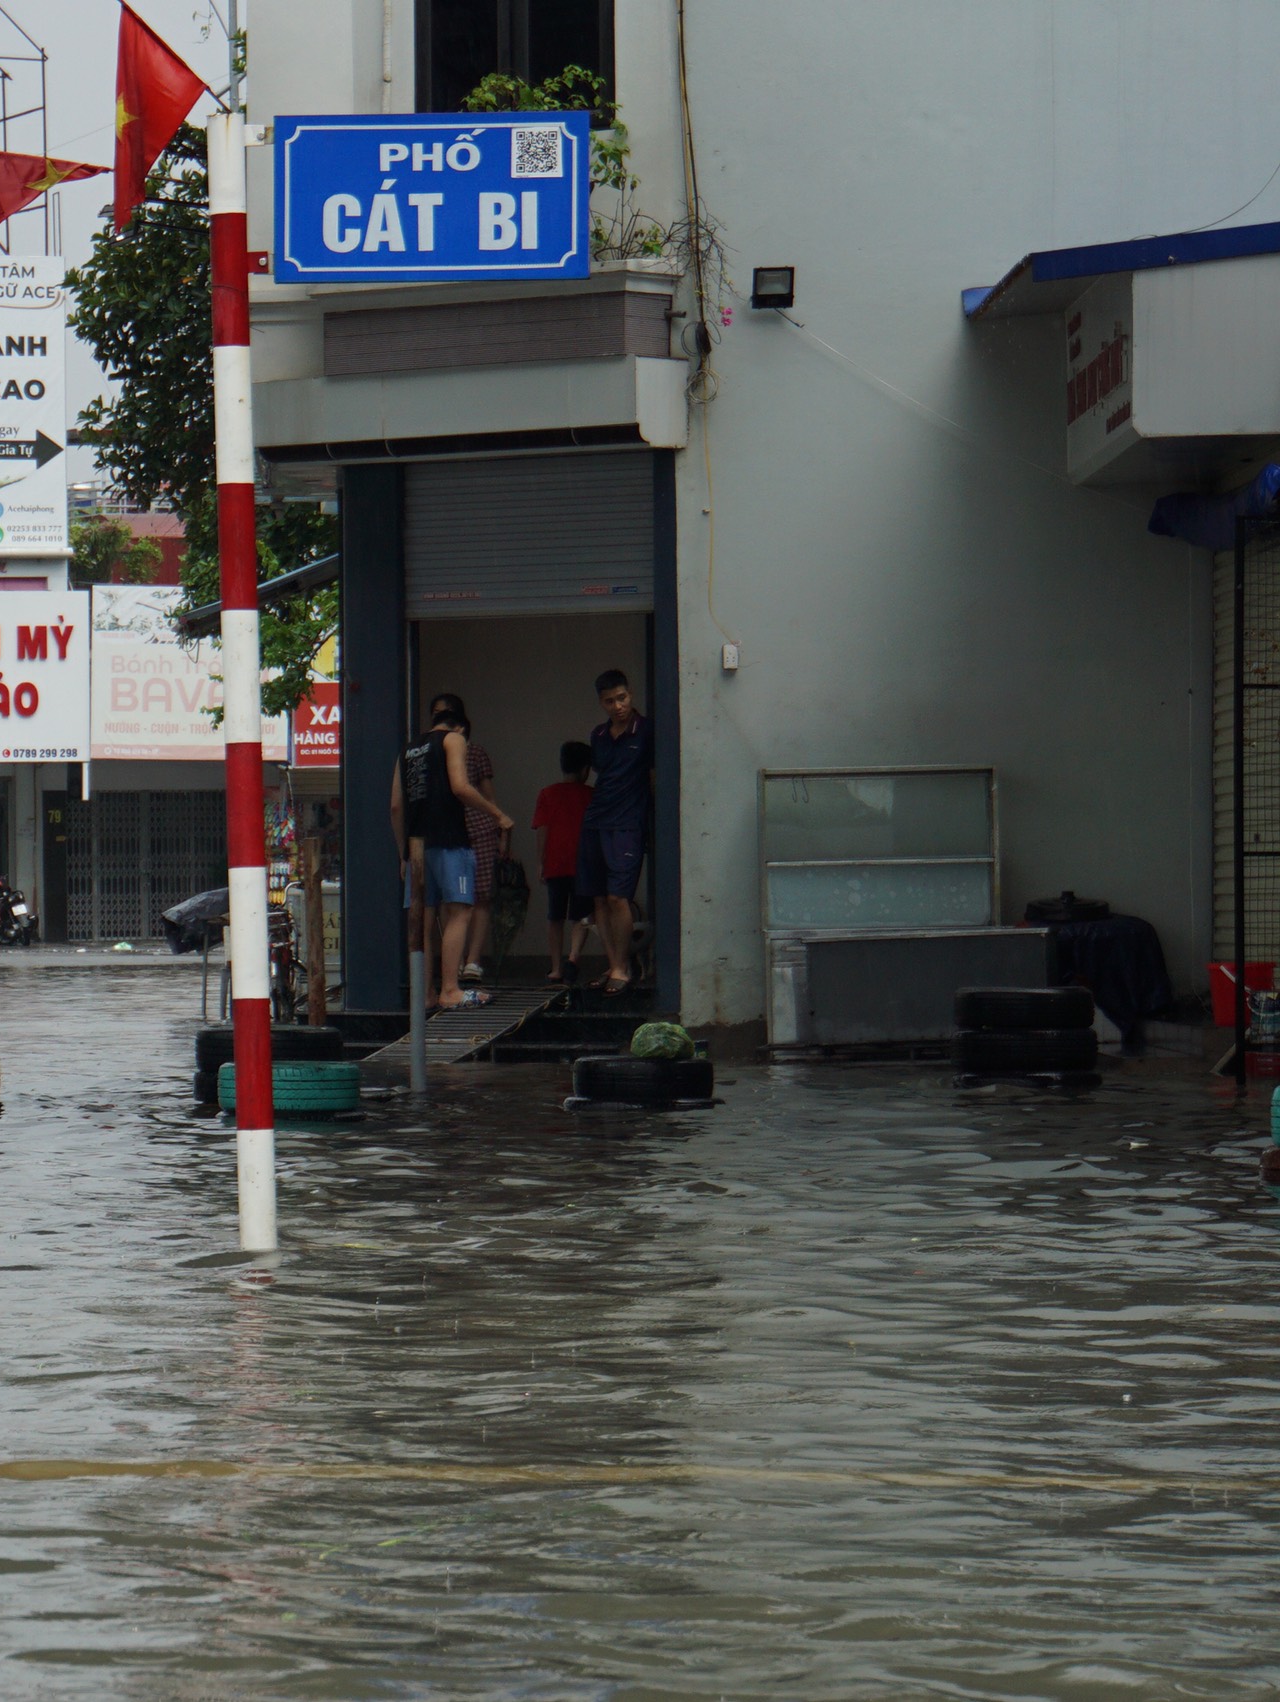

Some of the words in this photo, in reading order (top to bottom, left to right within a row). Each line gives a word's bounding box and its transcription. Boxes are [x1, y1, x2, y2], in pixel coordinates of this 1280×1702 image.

[380, 129, 486, 172] PHỐ
[322, 178, 444, 253] CÁT
[478, 191, 538, 250] BI
[1, 262, 35, 278] TÂM
[22, 286, 56, 299] ACE
[17, 444, 34, 459] Tự
[17, 615, 74, 660] MỲ
[111, 653, 173, 674] Bánh
[294, 730, 335, 745] HÀNG
[13, 748, 37, 758] 0789
[39, 748, 57, 758] 299
[60, 748, 78, 758] 298
[47, 810, 62, 823] 79
